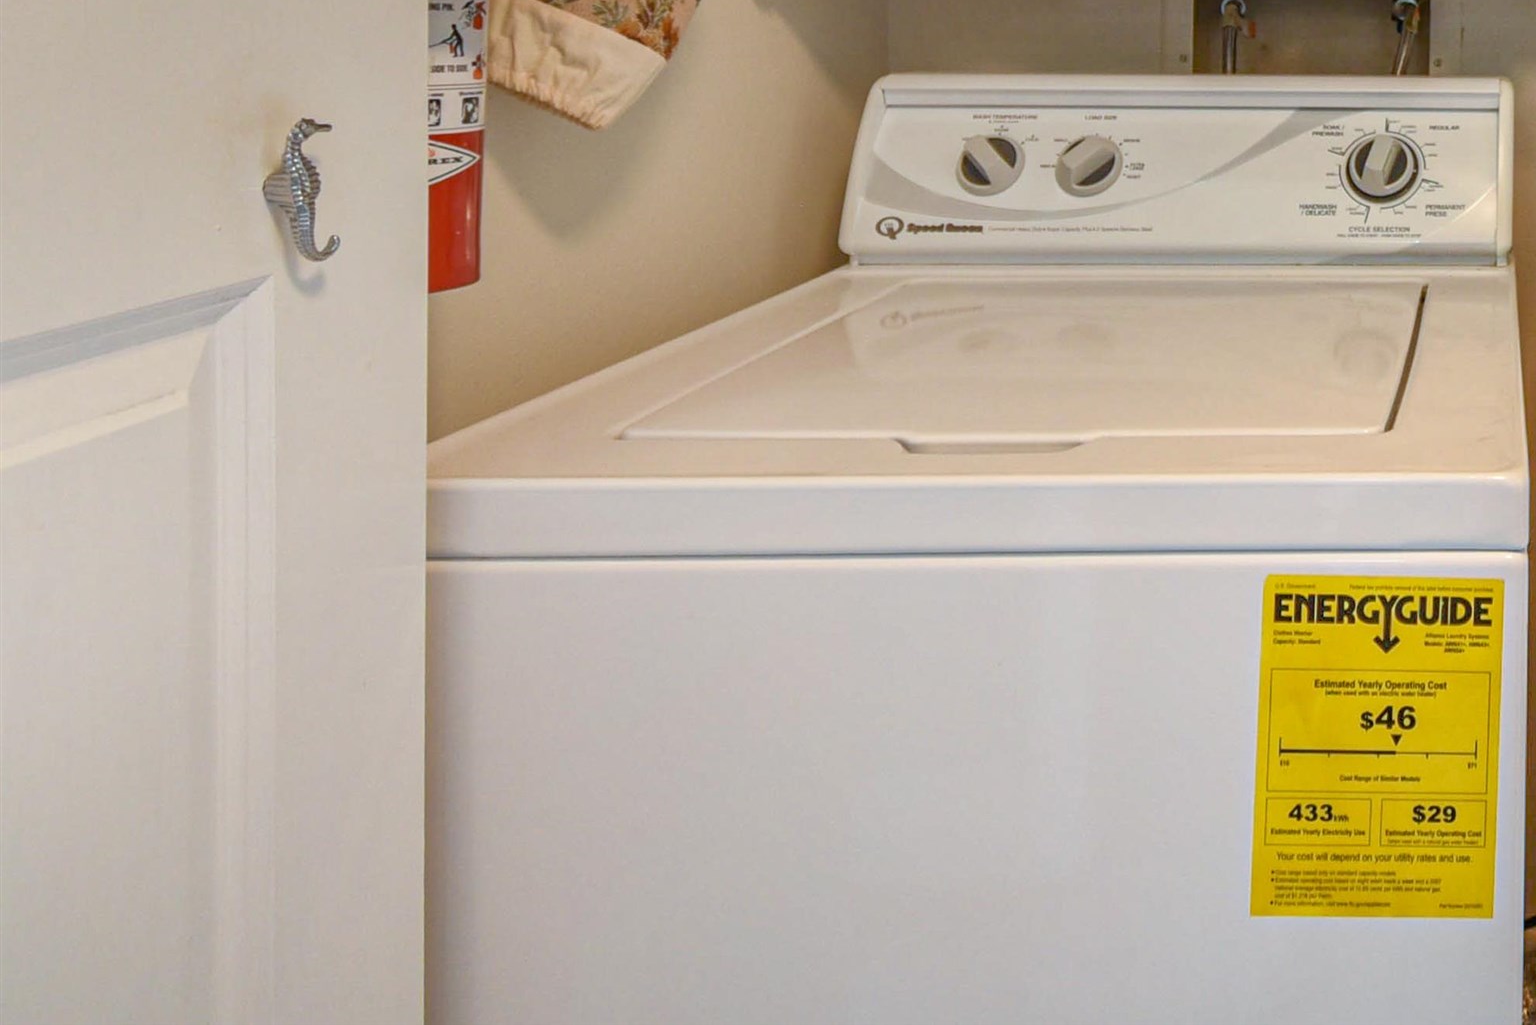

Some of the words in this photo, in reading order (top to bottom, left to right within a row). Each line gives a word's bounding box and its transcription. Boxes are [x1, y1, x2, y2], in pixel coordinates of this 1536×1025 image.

[428, 156, 464, 165] REX
[906, 222, 944, 235] Speed
[945, 223, 983, 234] Queen
[1274, 593, 1493, 627] ENERGYGUIDE
[1314, 679, 1355, 689] Estimated
[1358, 680, 1383, 691] Yearly
[1385, 680, 1425, 691] Operating
[1427, 681, 1447, 690] Cost
[1360, 705, 1417, 731] $46
[1288, 803, 1333, 822] 433
[1412, 805, 1457, 825] $29
[1322, 829, 1352, 837] Electricity
[1385, 829, 1415, 837] Estimated
[1416, 830, 1434, 838] Yearly
[1436, 830, 1466, 839] Operating
[1277, 852, 1296, 861] Your
[1297, 853, 1314, 861] cost
[1315, 853, 1328, 861] will
[1330, 853, 1361, 863] depend
[1375, 855, 1392, 864] your
[1394, 854, 1415, 864] utility
[1416, 854, 1437, 863] rates
[1439, 855, 1455, 863] and
